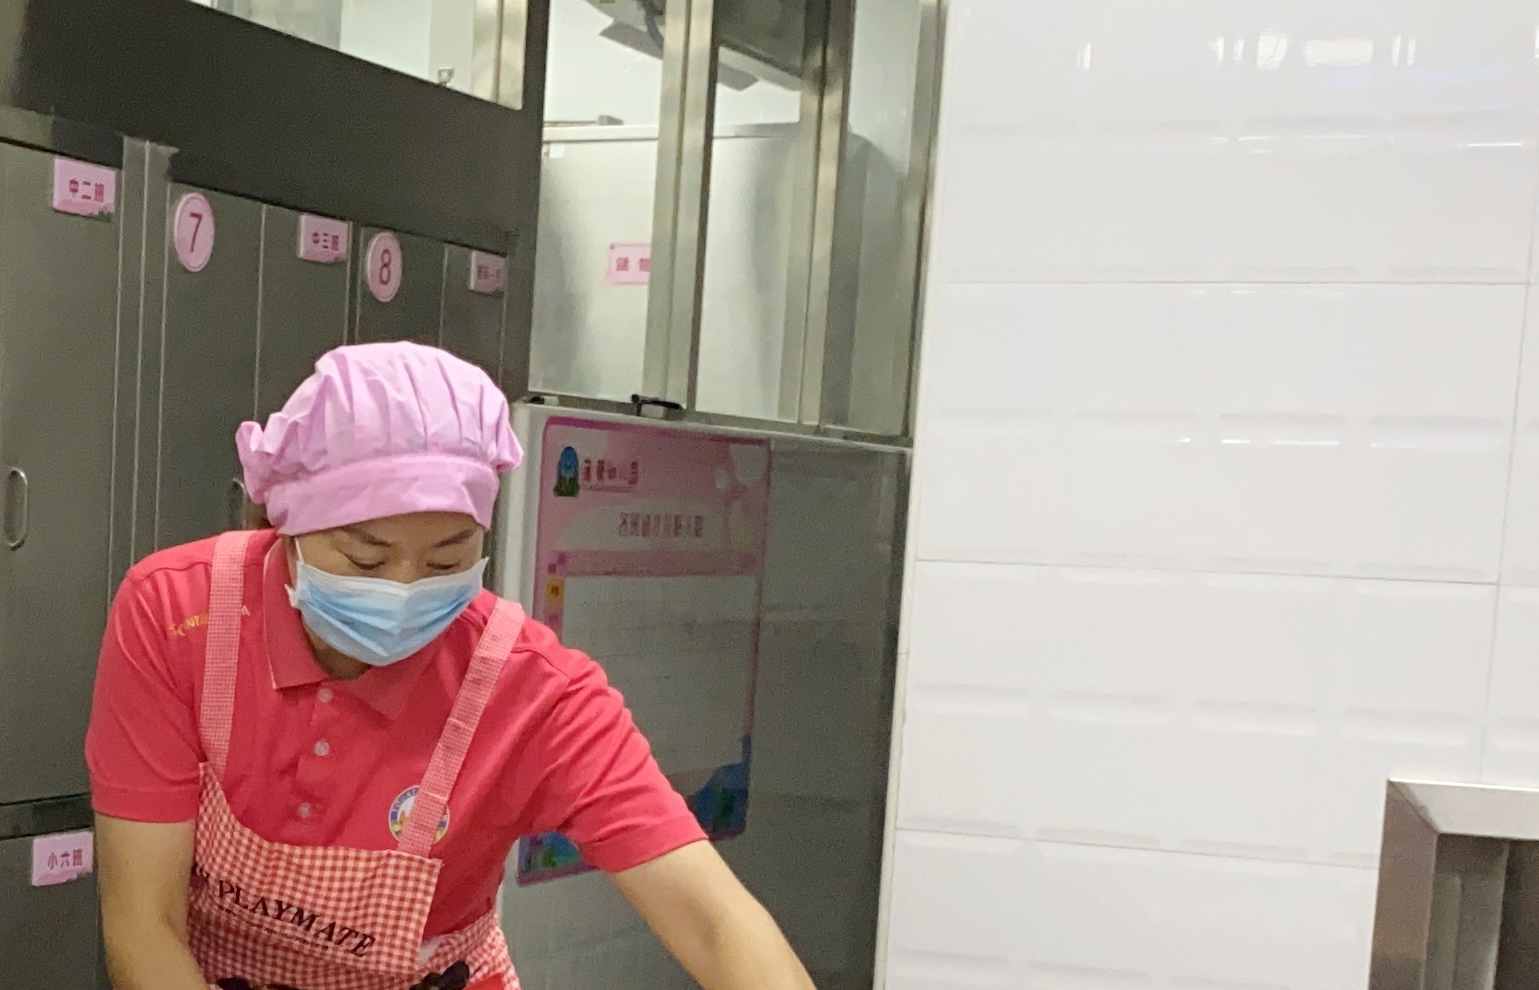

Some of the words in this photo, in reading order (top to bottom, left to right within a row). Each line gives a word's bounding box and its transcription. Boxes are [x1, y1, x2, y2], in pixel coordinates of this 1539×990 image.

[189, 211, 203, 253] 7
[378, 248, 392, 286] 8
[47, 847, 83, 872] 小六班
[218, 879, 377, 958] PLAYMATE
